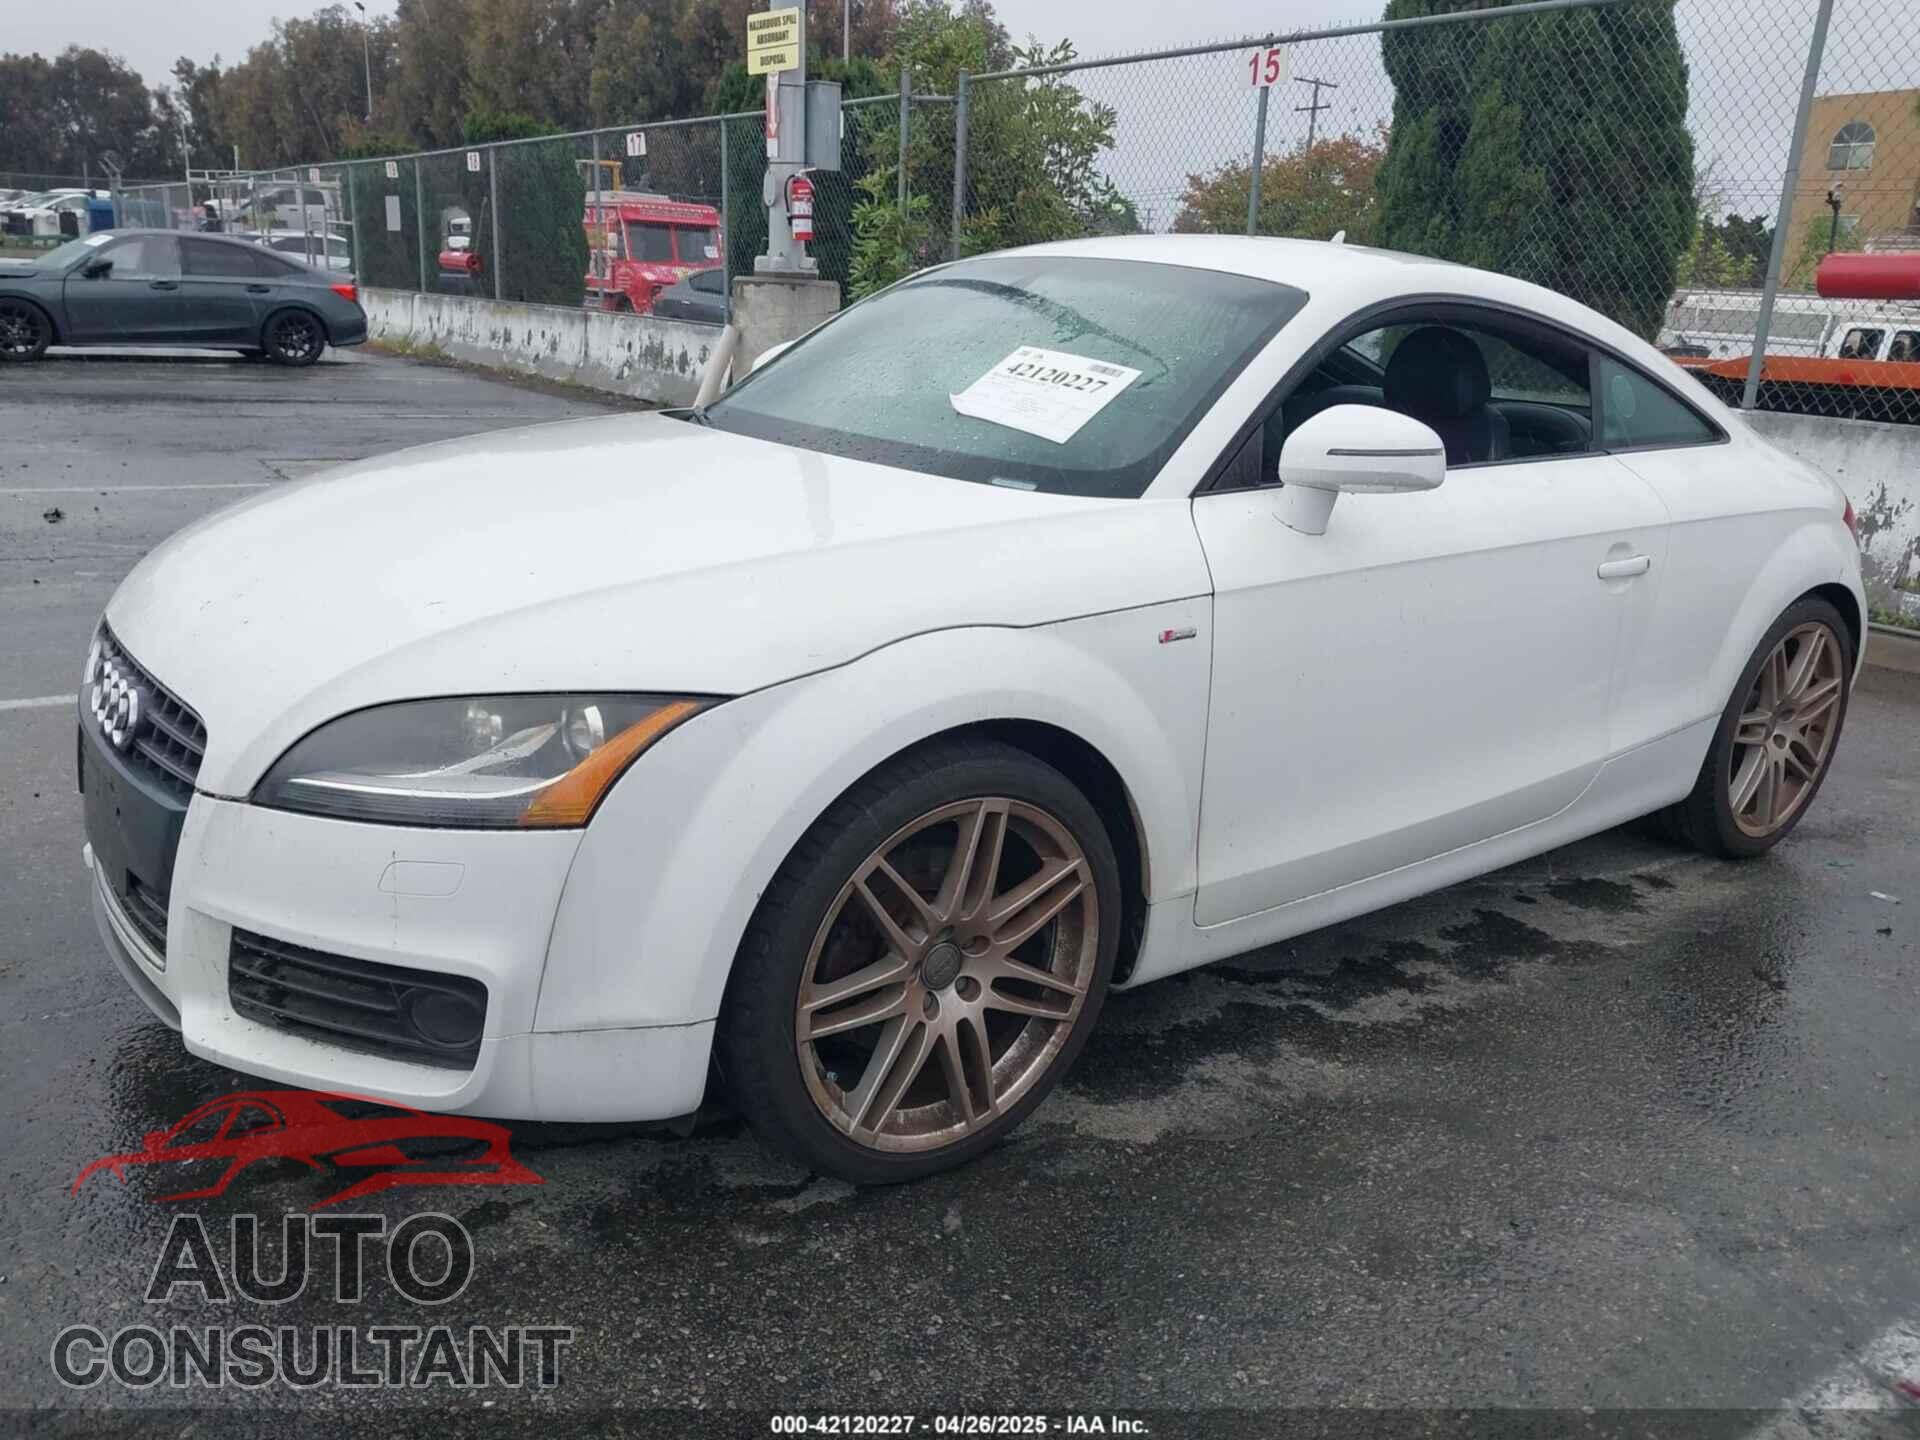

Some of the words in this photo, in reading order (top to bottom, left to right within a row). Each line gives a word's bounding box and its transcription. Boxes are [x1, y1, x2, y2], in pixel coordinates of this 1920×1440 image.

[760, 53, 786, 66] DISPOSAL
[1249, 49, 1281, 86] 15
[630, 134, 642, 154] 17
[1007, 362, 1108, 394] 42120227
